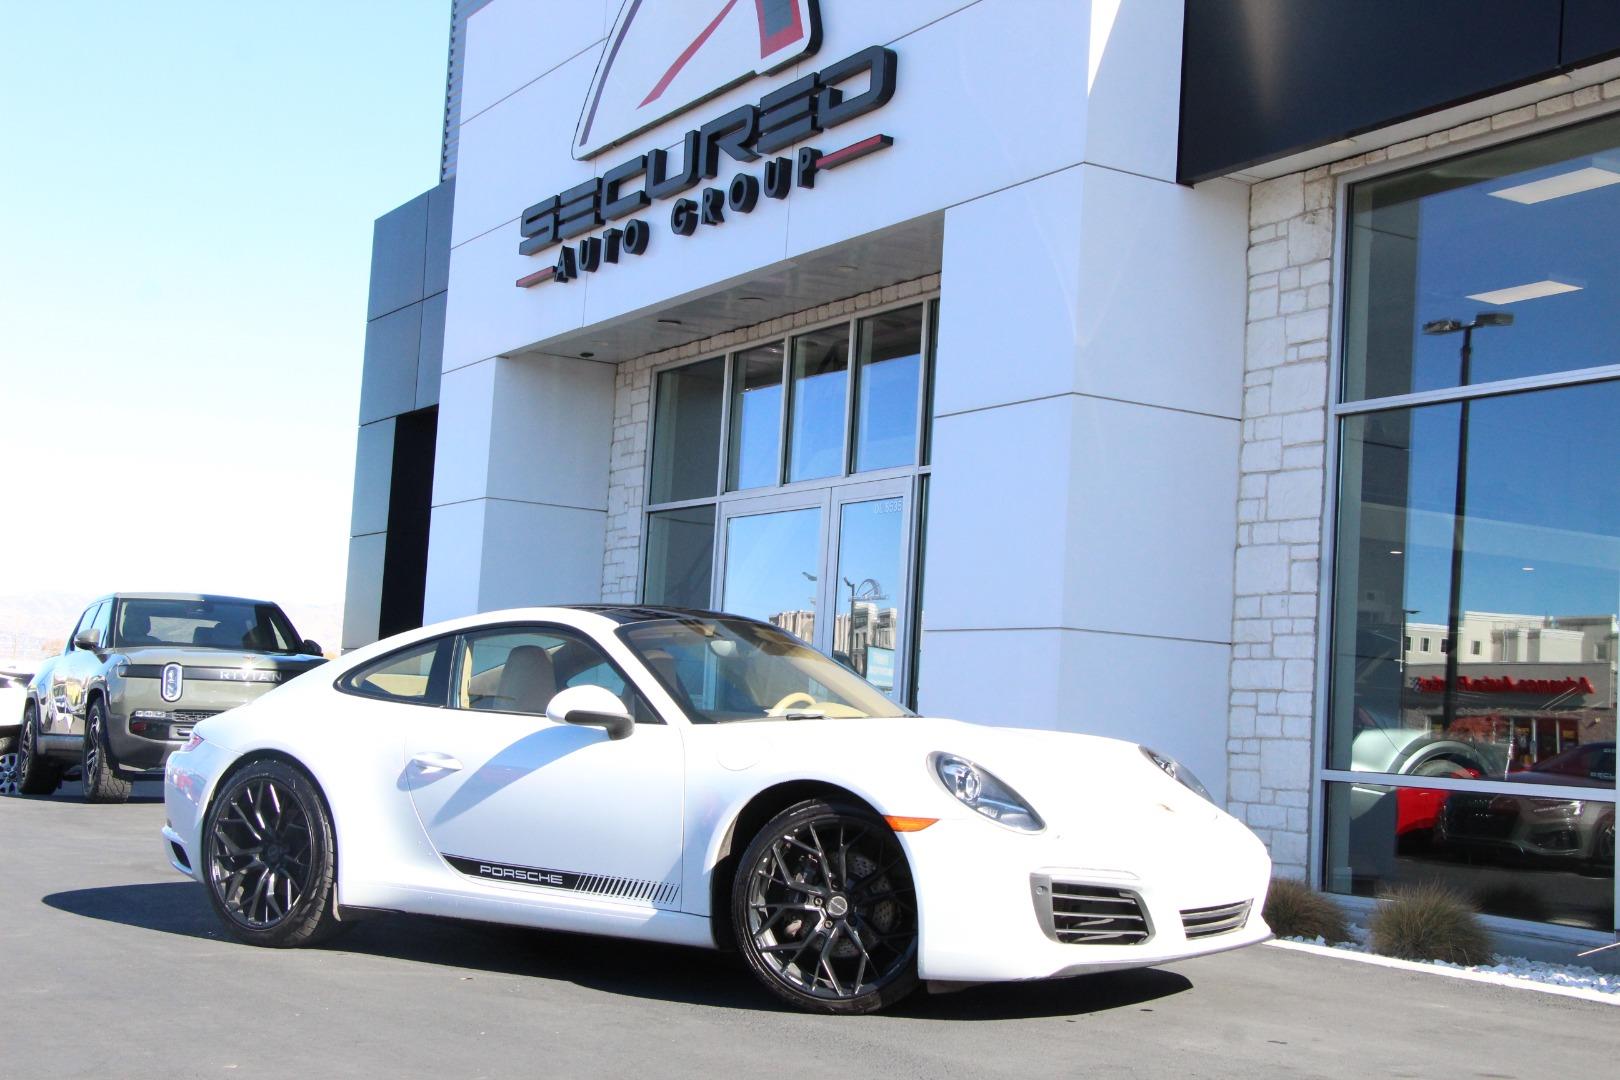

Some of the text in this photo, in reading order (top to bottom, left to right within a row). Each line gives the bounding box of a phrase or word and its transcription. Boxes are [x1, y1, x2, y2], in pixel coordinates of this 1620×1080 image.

[518, 45, 898, 256] SECURED
[554, 146, 823, 283] AUTO GROUP
[219, 670, 282, 682] RIVIAN
[480, 865, 563, 885] PORSCHE
